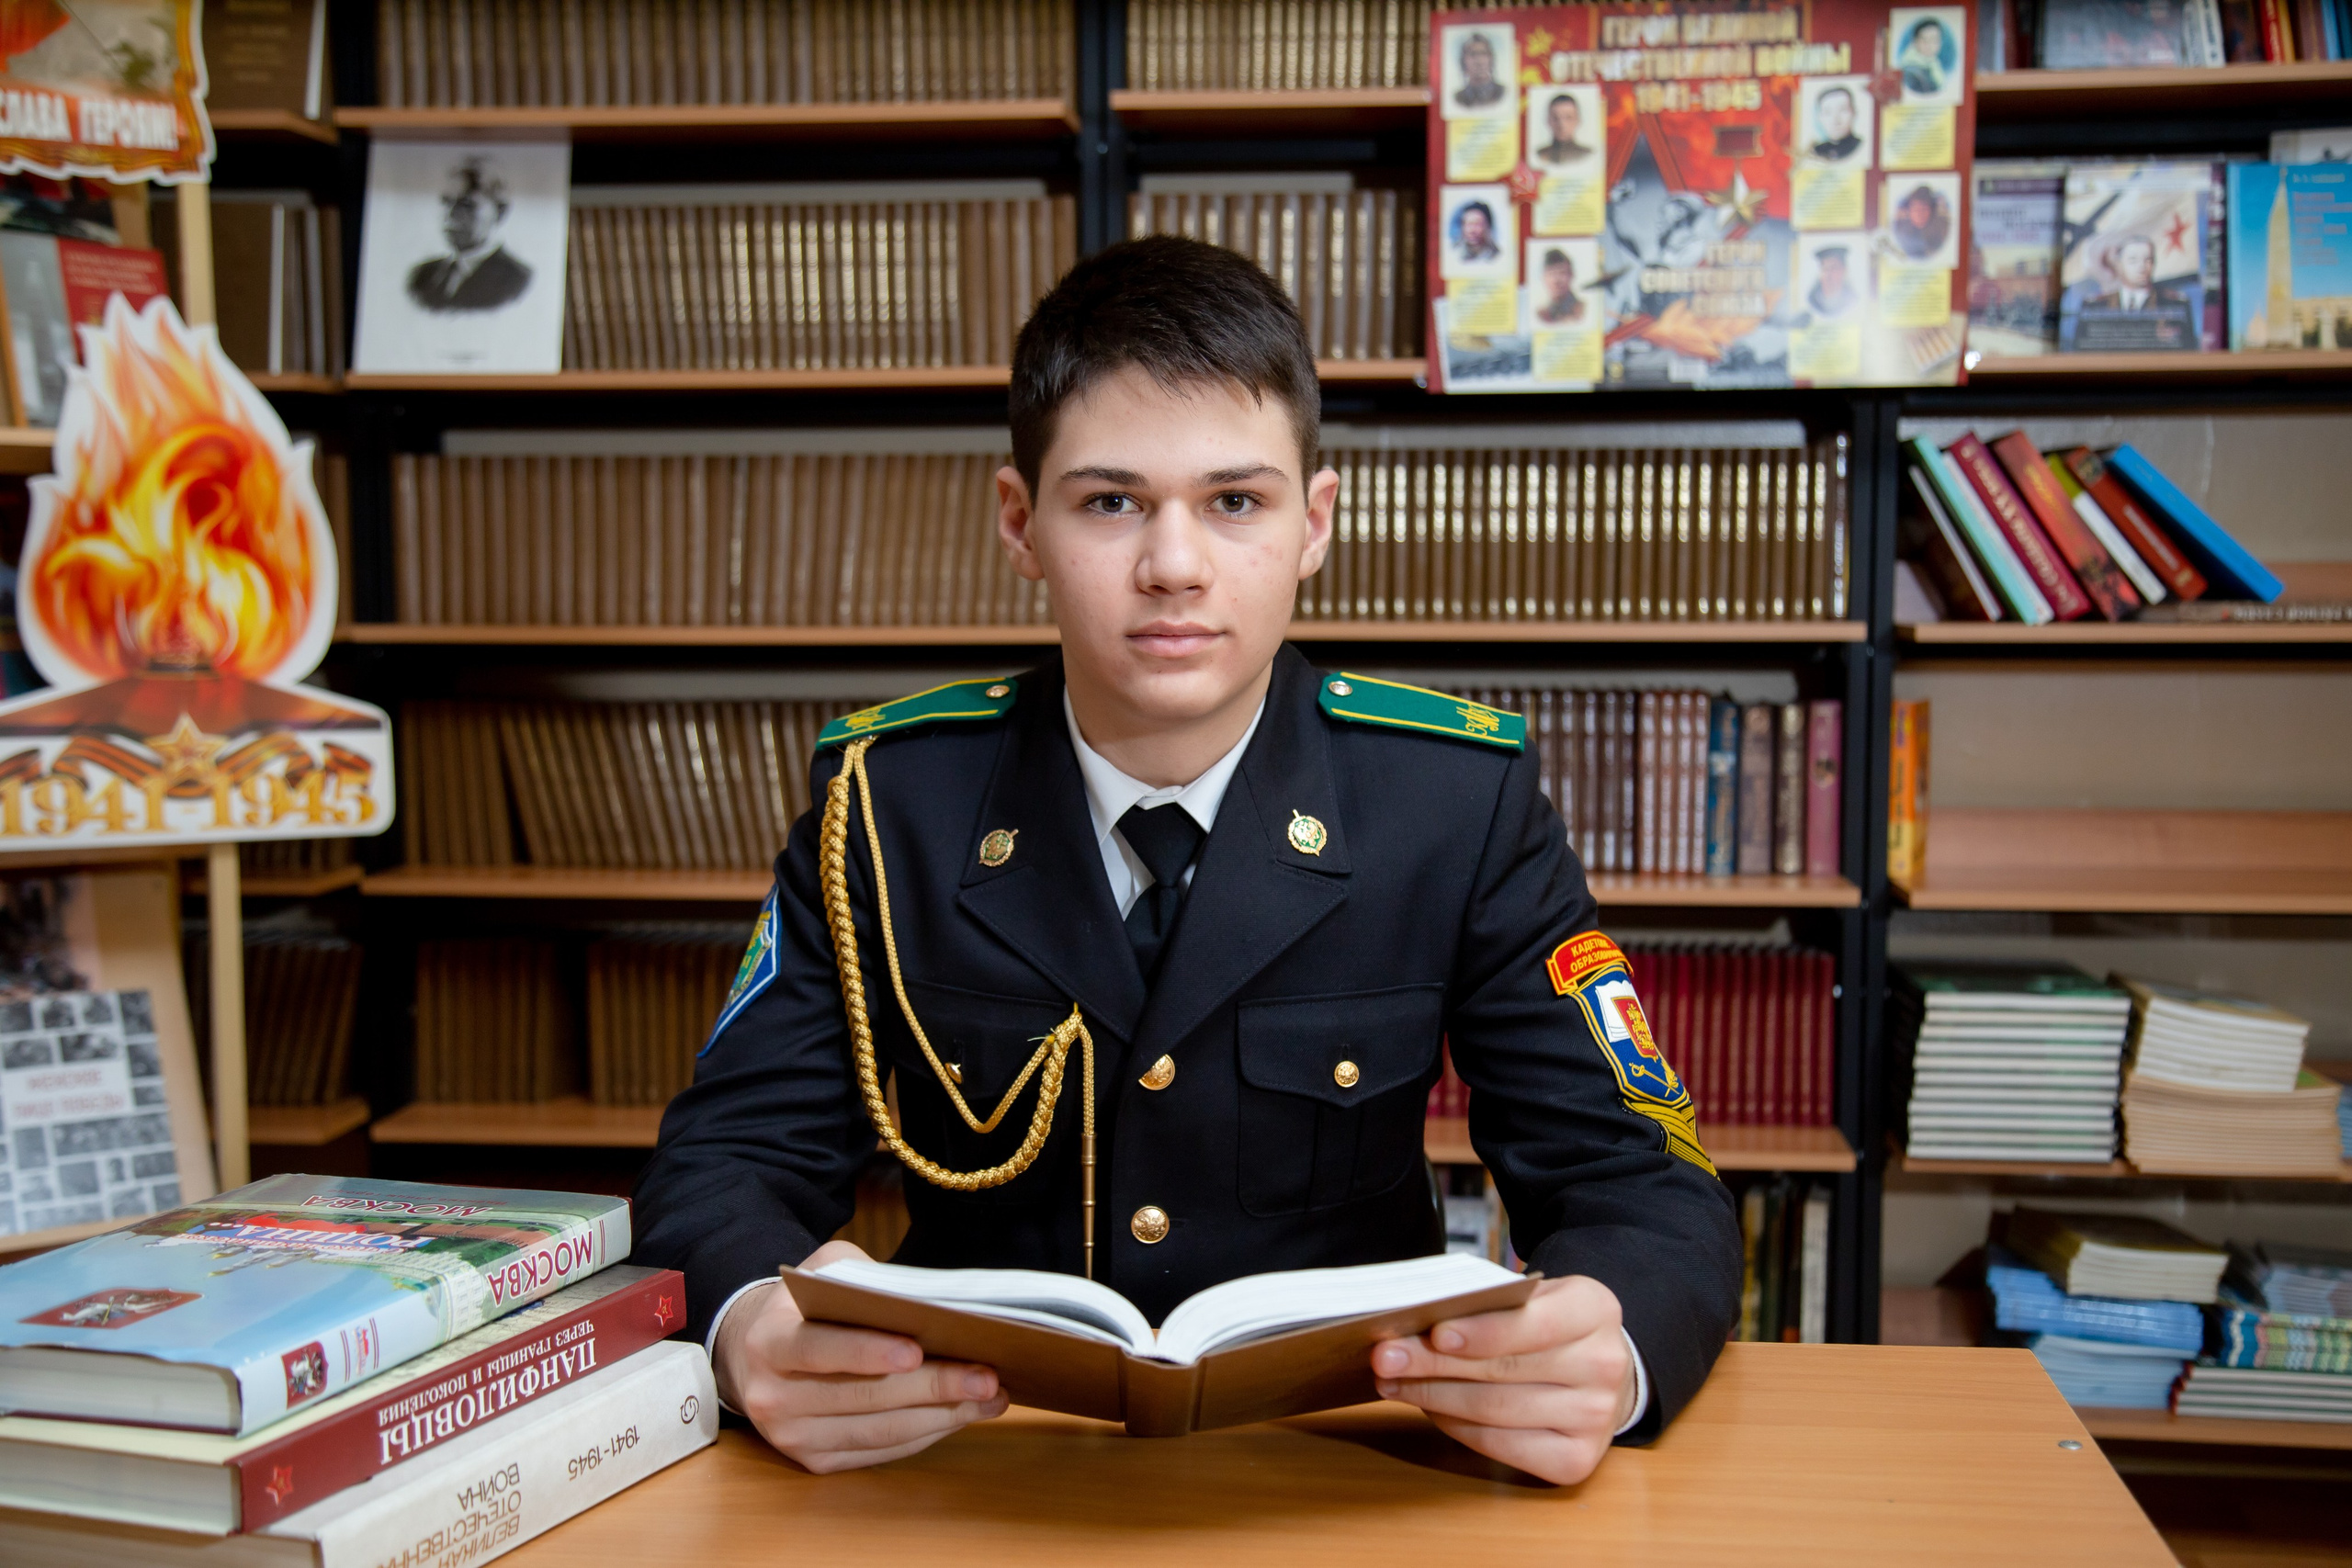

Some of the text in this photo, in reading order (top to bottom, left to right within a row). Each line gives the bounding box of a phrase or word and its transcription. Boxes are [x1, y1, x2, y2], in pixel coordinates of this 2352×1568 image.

[300, 1195, 493, 1217] МОСКВА
[486, 1228, 594, 1307] МОСКВА
[378, 1320, 595, 1427] ЧЕРЕЗ ГРАНИЦЫ И ПОКОЛЕНИЯ
[379, 1337, 597, 1466] ПАНФИЛОВЦЫ
[457, 1462, 521, 1512] ВОЙНА
[568, 1425, 640, 1482] 1941-1945
[376, 1490, 522, 1568] ОТЕЧЕСТВЕНН
